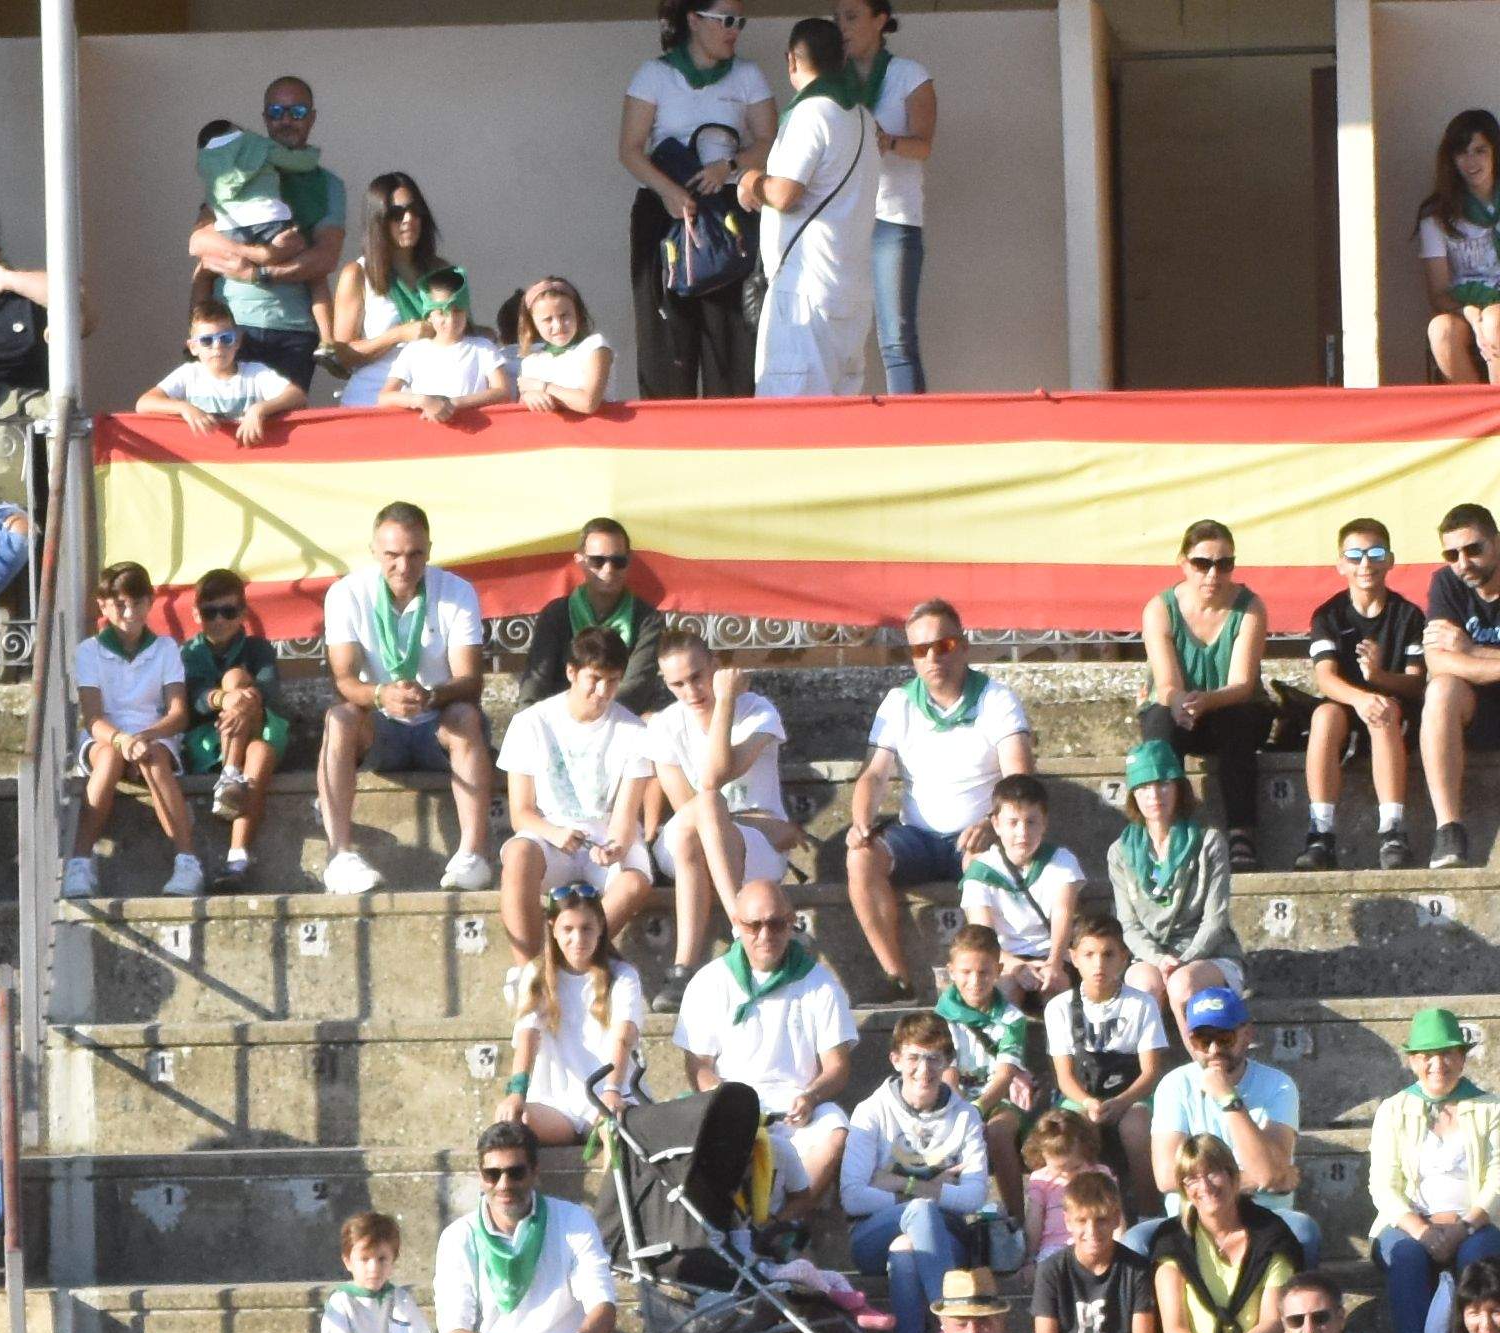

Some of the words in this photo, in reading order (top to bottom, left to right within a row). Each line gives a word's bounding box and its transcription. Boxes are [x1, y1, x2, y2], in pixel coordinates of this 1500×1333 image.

[1107, 783, 1122, 802] 7
[1274, 901, 1288, 921] 8
[303, 922, 318, 943] 2
[463, 920, 479, 939] 3
[478, 1047, 495, 1067] 3
